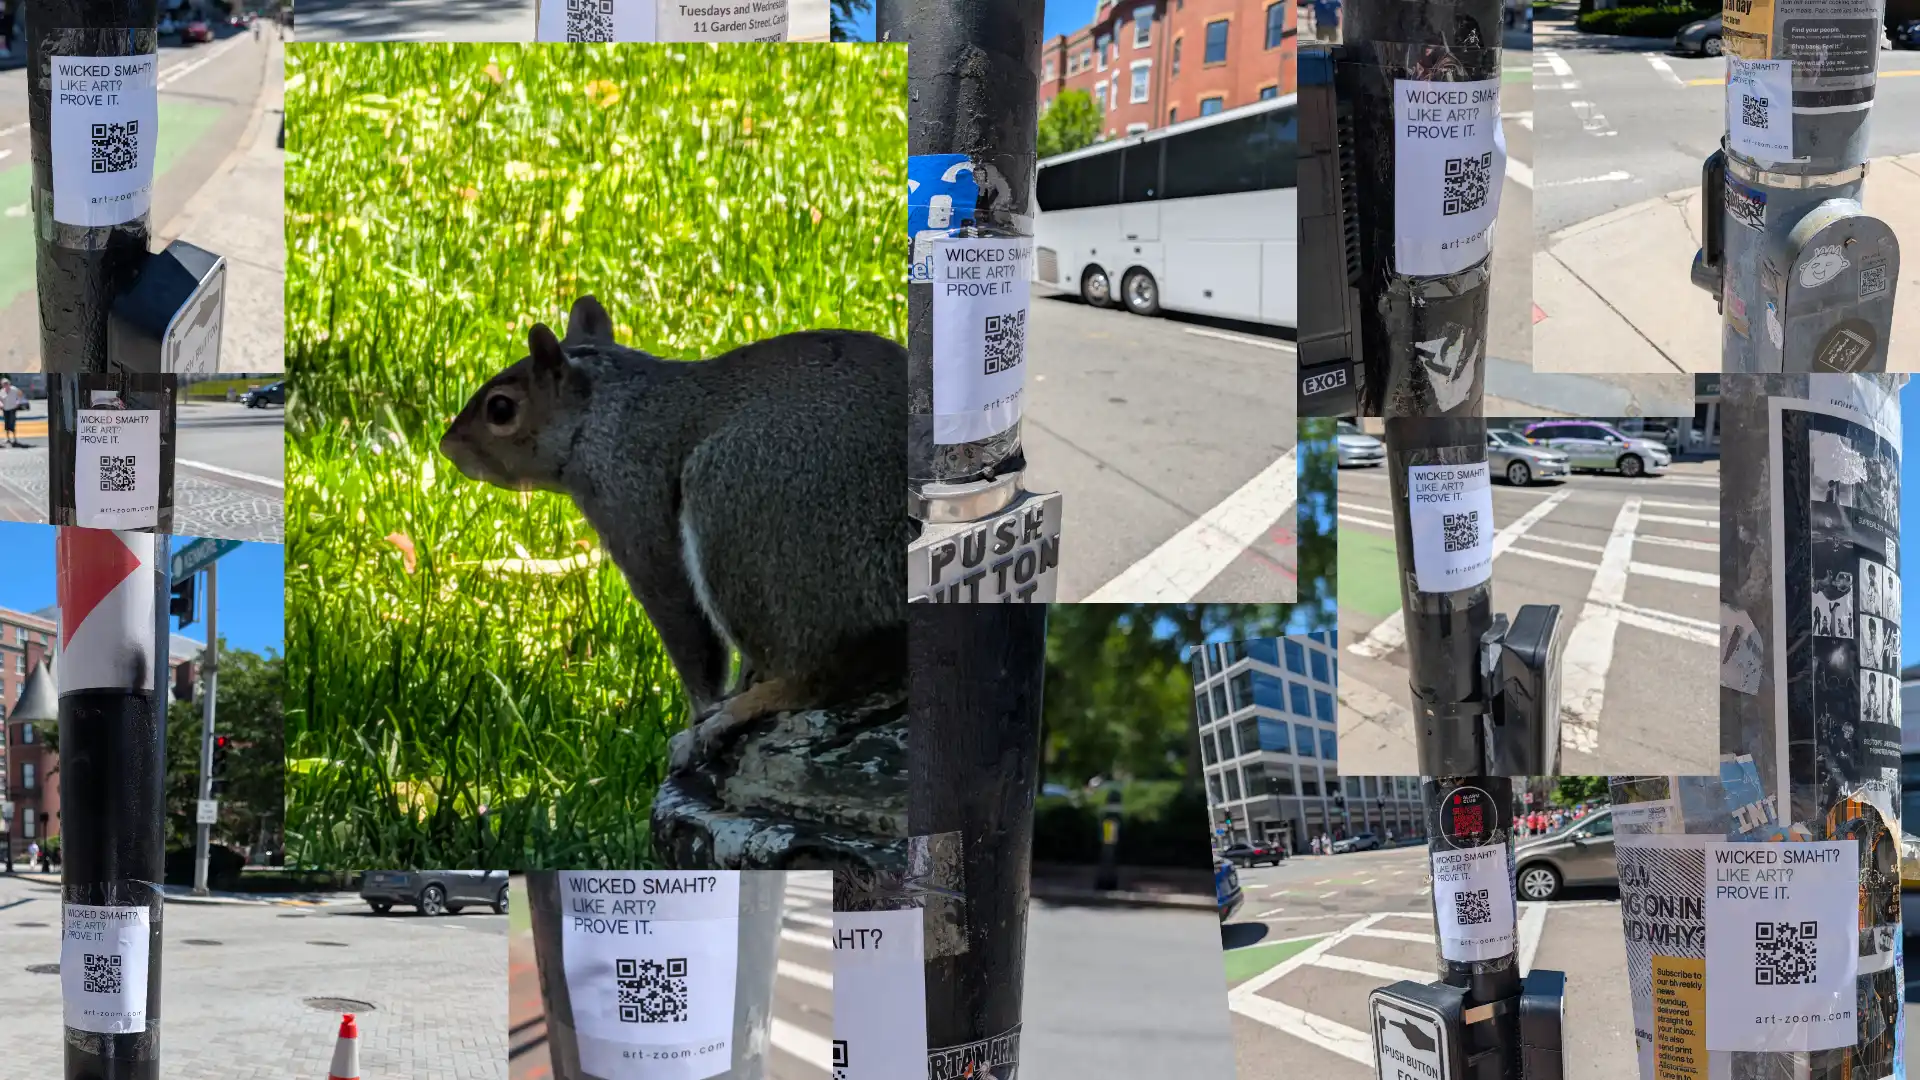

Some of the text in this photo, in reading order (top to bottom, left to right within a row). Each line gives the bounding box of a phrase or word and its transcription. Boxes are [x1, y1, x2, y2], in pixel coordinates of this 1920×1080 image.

[679, 5, 731, 17] Tuesdays
[733, 3, 750, 15] and
[693, 21, 708, 32] 11
[710, 20, 746, 32] Garden
[59, 62, 152, 77] WICKED SMAHT?
[1751, 62, 1780, 71] SMAHT?
[60, 80, 123, 92] LIKE ART?
[60, 94, 119, 106] PROVE IT.
[1406, 90, 1467, 104] WICKED
[1407, 107, 1479, 122] LIKE ART?
[1407, 124, 1475, 138] PROVE IT.
[945, 248, 1005, 262] WICKED
[947, 264, 1015, 280] LIKE ART?
[947, 281, 1013, 297] PROVE IT.
[1303, 369, 1346, 396] EXOE
[80, 415, 150, 425] WICKED SMAHT?
[80, 425, 122, 434] LIKE ART?
[80, 435, 120, 444] PROVE IT.
[1414, 471, 1454, 481] WICKED
[1415, 481, 1464, 492] LIKE ART?
[1416, 492, 1463, 503] PROVE IT.
[100, 505, 155, 513] art-zoom.com
[926, 500, 1047, 588] PUSH
[1436, 850, 1497, 864] WICKED SMAHT?
[1715, 848, 1840, 864] WICKED SMAHT?
[1451, 863, 1472, 872] ART?
[1437, 872, 1471, 882] PROVE IT.
[1716, 868, 1794, 882] LIKE ART?
[569, 876, 717, 895] WICKED SMAHT?
[1716, 886, 1790, 900] PROVE IT.
[572, 898, 657, 915] LIKE ART?
[1644, 894, 1675, 919] ON
[1680, 896, 1702, 920] IN
[68, 908, 138, 920] WICKED SMAHT?
[84, 921, 107, 931] ART?
[574, 917, 653, 935] PROVE IT.
[68, 930, 104, 941] PROVE IT.
[833, 928, 883, 950] HT?
[1646, 922, 1705, 949] WHY?
[1657, 968, 1702, 980] Subscribe to
[1656, 988, 1675, 996] news
[1656, 997, 1689, 1009] roundup,
[1656, 1006, 1689, 1017] delivered
[1755, 1010, 1851, 1024] art-zoom.com
[1658, 1015, 1693, 1026] straight to
[1657, 1025, 1672, 1034] your
[1657, 1033, 1685, 1044] We also
[622, 1041, 725, 1060] art-zoom.com
[1658, 1043, 1692, 1055] send print
[1384, 1044, 1439, 1080] PUSH BUTTON
[1658, 1053, 1685, 1063] editions
[1397, 1068, 1419, 1080] FO
[1659, 1069, 1675, 1079] Tune
